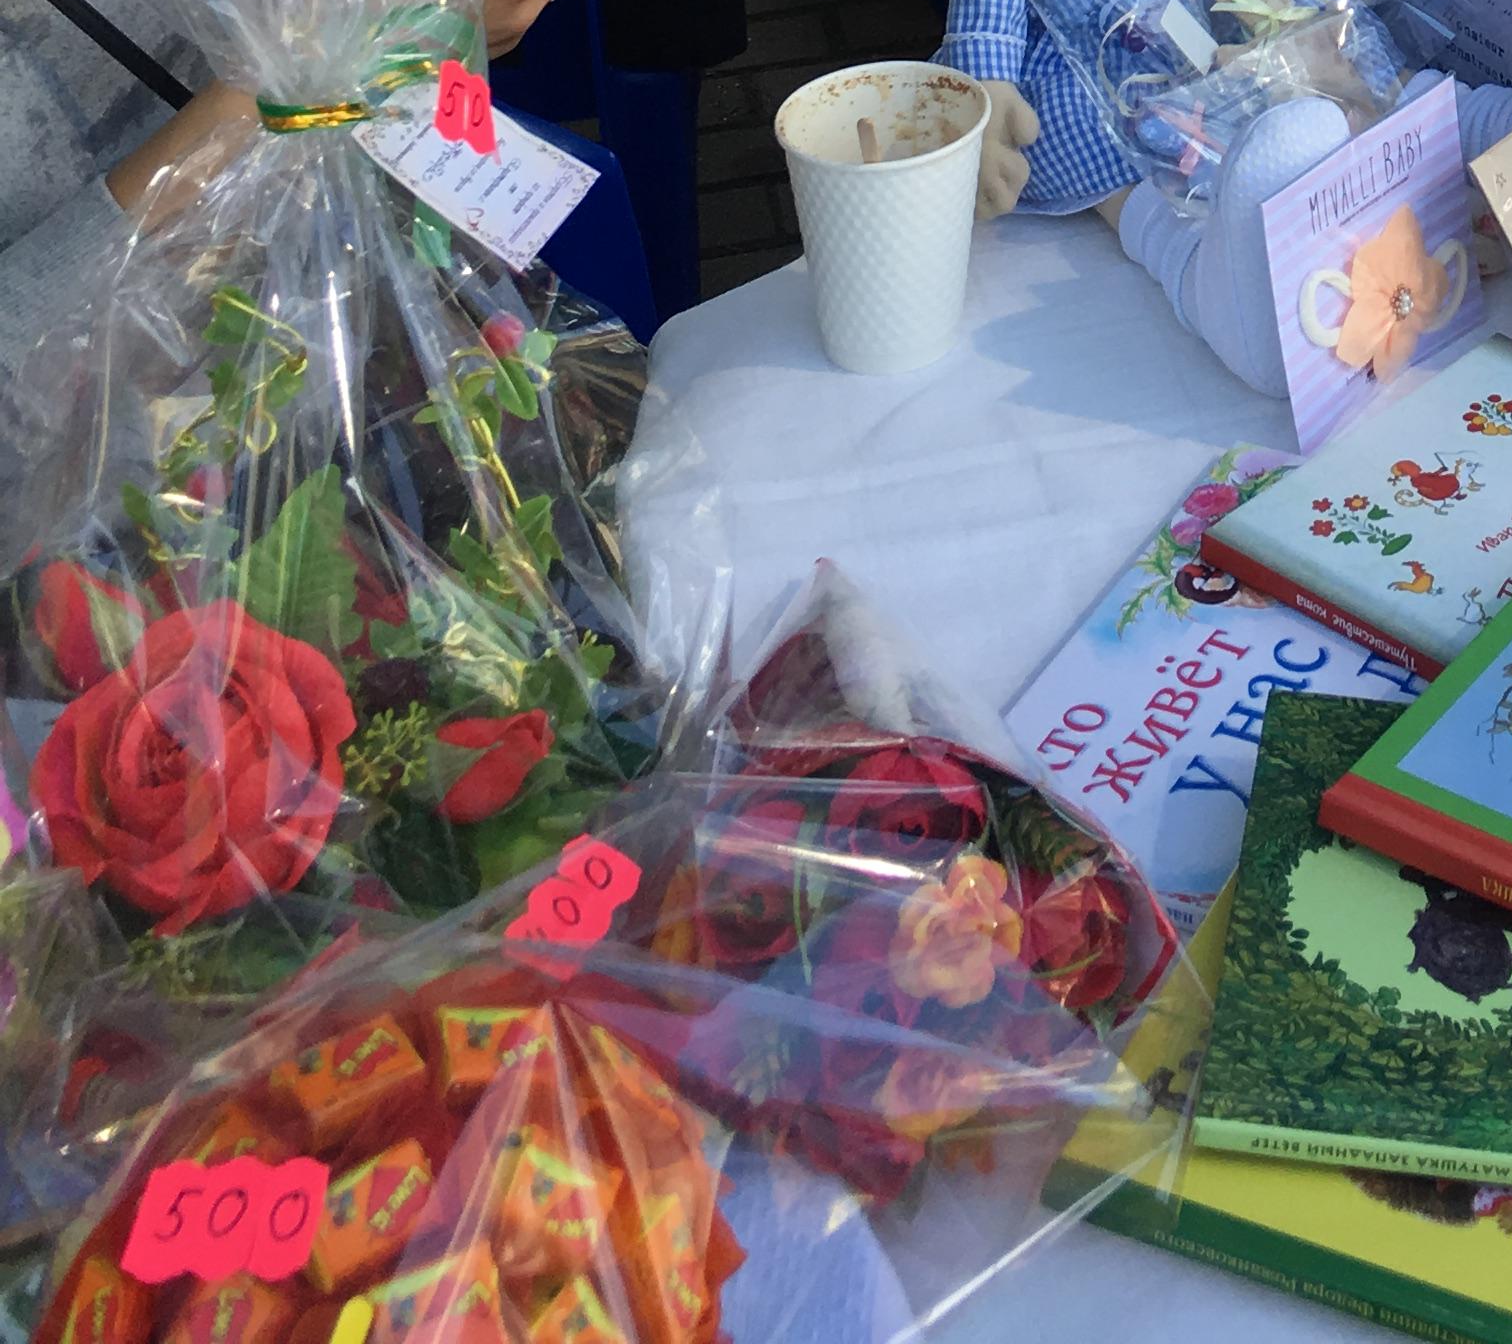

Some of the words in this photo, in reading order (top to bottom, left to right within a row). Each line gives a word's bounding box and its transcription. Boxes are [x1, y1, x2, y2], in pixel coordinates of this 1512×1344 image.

[1294, 592, 1330, 620] кота
[1331, 611, 1418, 672] Путешествие
[1249, 1134, 1302, 1156] ВЕТЕР
[1306, 1142, 1413, 1170] ЗАПАДНЫЙ
[1415, 1154, 1511, 1178] МАТУШКА
[153, 1185, 311, 1243] 500
